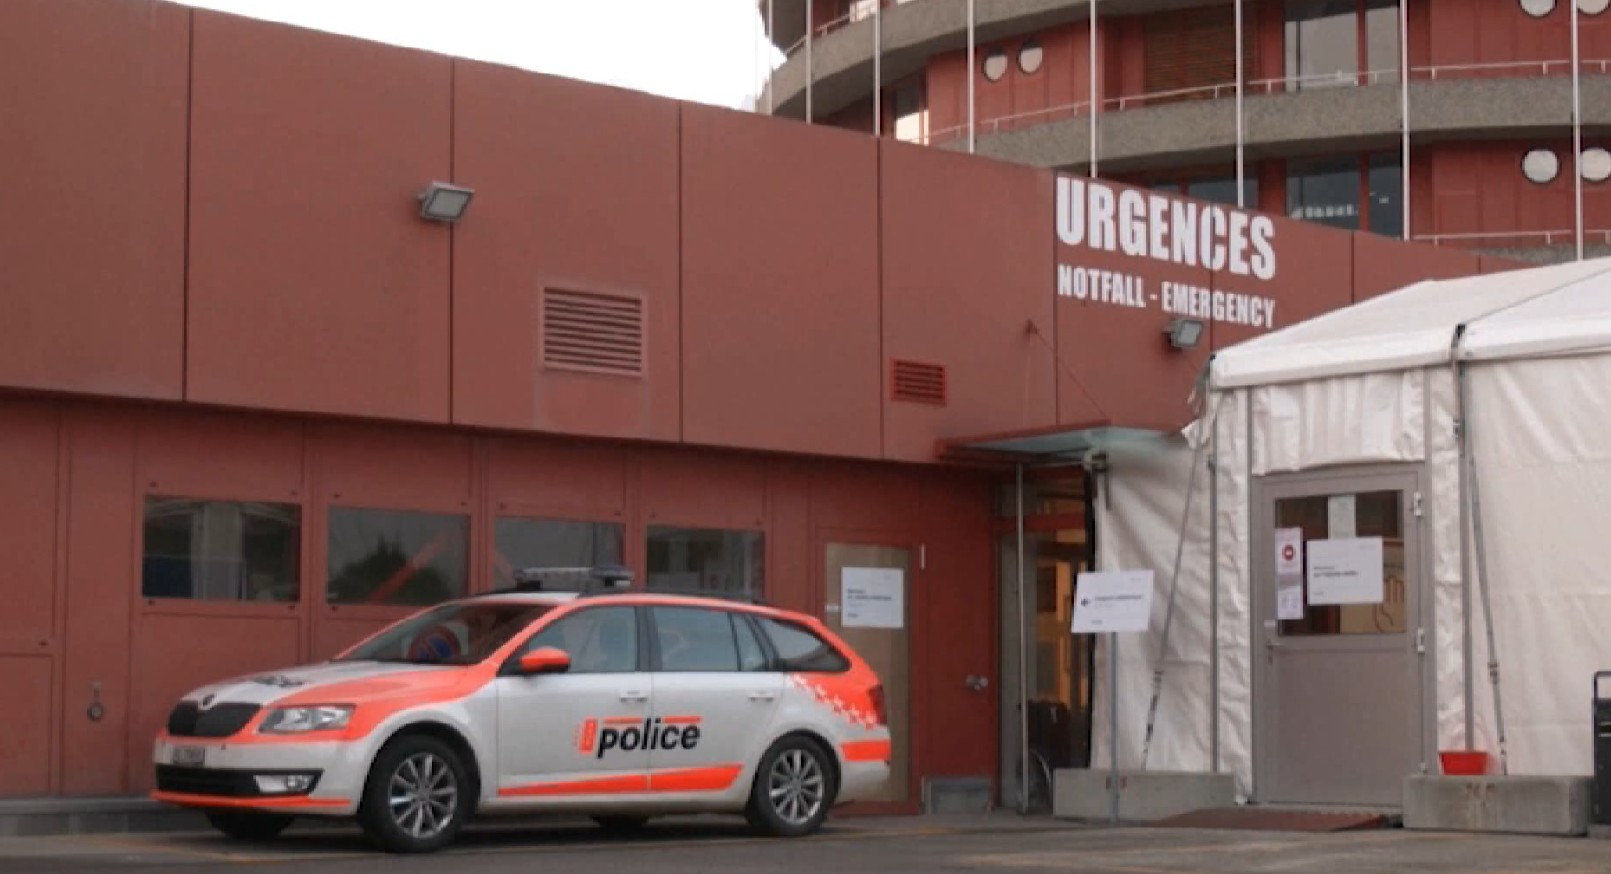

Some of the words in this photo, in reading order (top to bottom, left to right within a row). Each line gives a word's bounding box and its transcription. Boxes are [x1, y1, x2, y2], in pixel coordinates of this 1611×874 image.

[1056, 176, 1275, 280] URGENCES
[1057, 263, 1146, 307] NOTFALL
[1161, 281, 1275, 327] EMERGENCY
[597, 718, 700, 759] police
